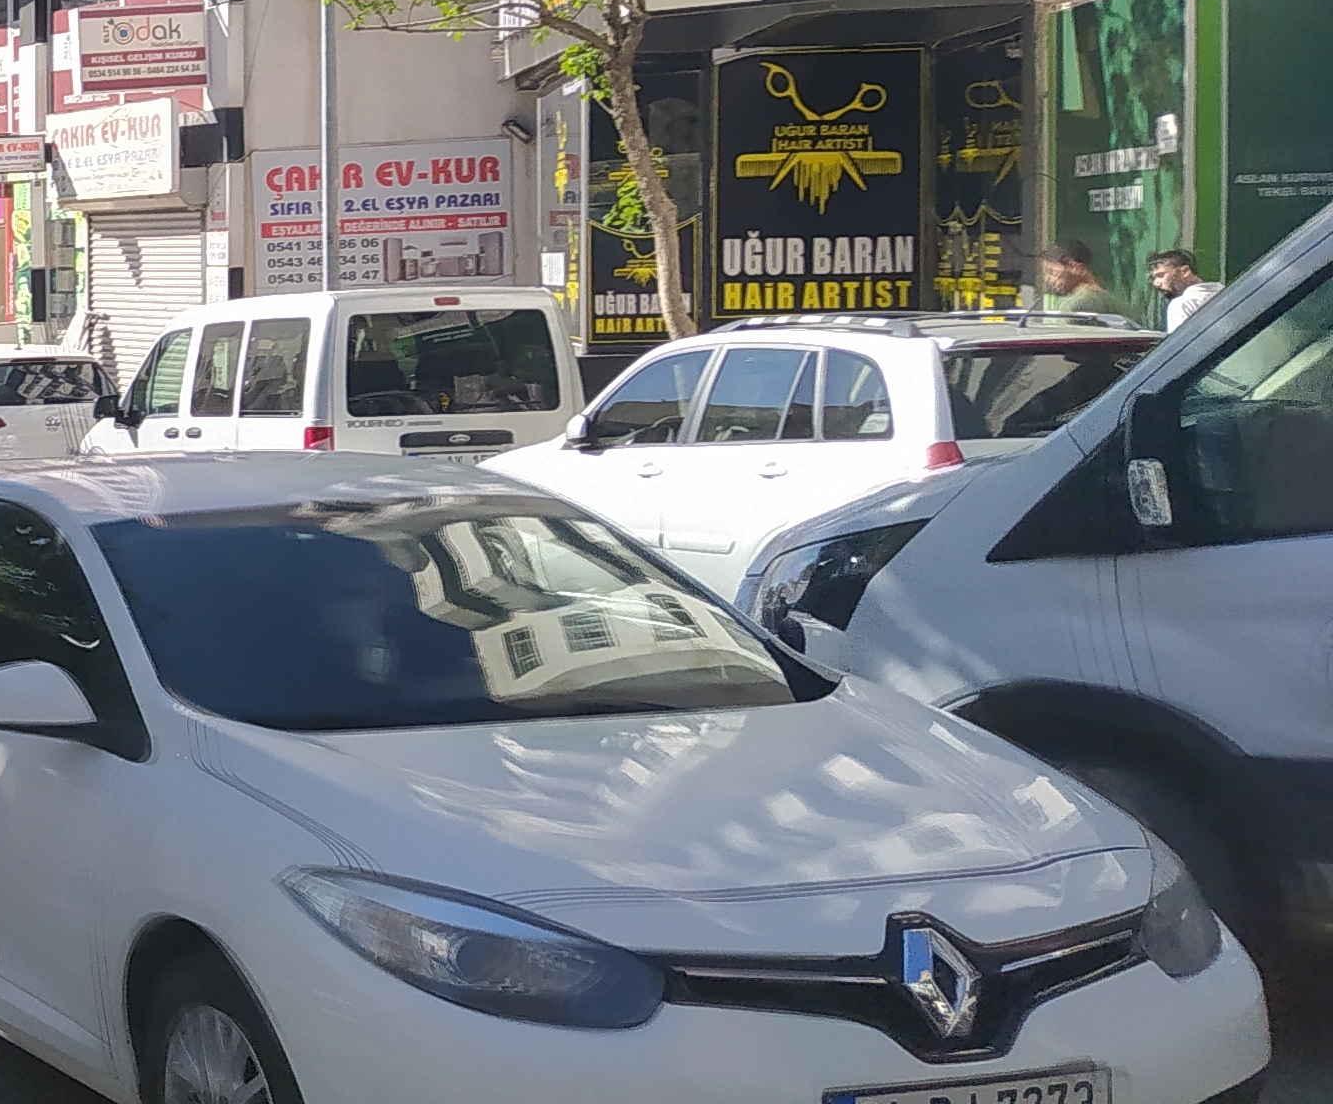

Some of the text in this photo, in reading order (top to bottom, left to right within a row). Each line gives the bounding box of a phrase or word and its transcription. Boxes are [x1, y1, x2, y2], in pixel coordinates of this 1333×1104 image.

[101, 113, 162, 144] EV-KUR
[774, 123, 870, 137] UĞUR BARAN
[266, 155, 501, 201] ÇAKR EV-KUR
[269, 201, 313, 216] SIFIR
[344, 198, 380, 213] 2.EL
[385, 195, 430, 214] EŞYA
[435, 192, 501, 208] PAZARI
[343, 218, 406, 234] DEĞERİNDE
[267, 241, 302, 253] 0541
[361, 237, 379, 248] 06
[722, 229, 915, 277] UĞUR BARAN
[267, 257, 303, 268] 0543
[339, 255, 357, 266] 34
[361, 254, 380, 264] 56
[267, 273, 303, 284] 0543
[339, 271, 357, 281] 48
[361, 269, 380, 280] 47
[594, 290, 637, 316] UĞUR
